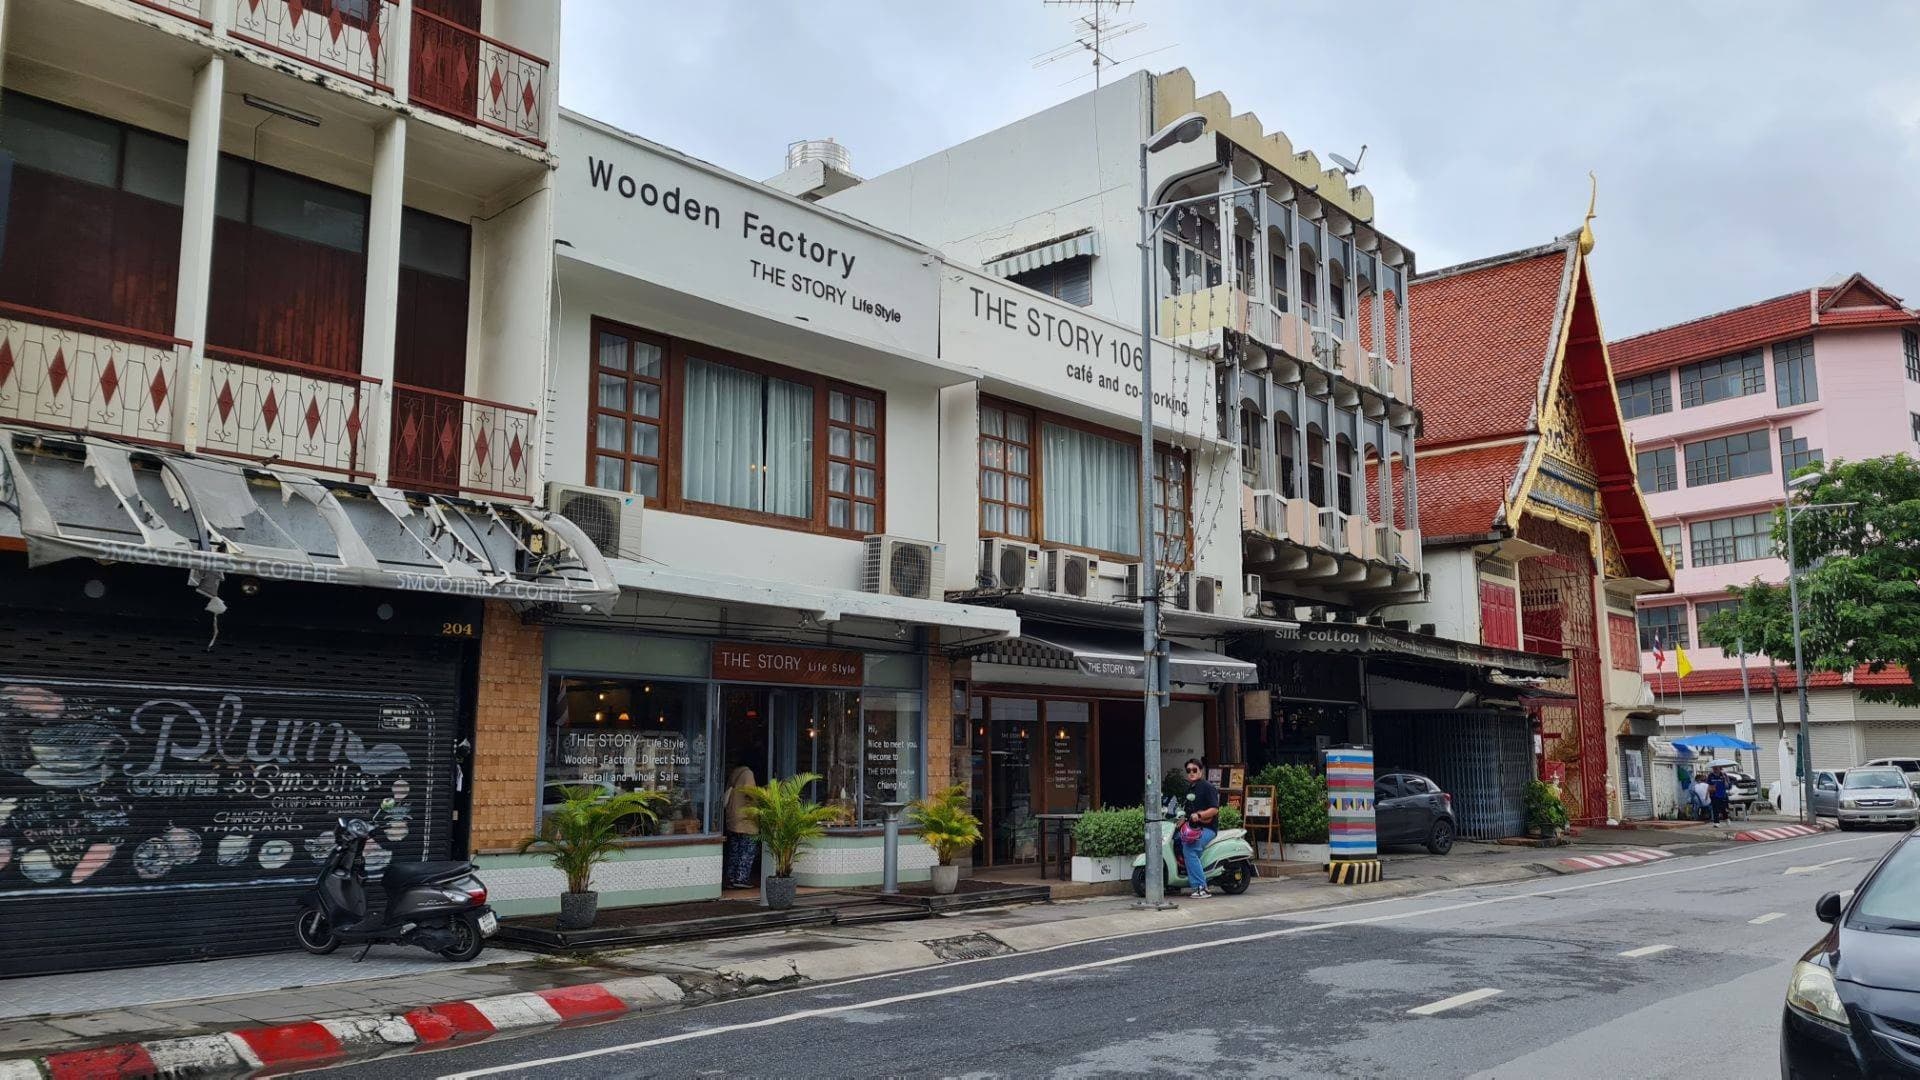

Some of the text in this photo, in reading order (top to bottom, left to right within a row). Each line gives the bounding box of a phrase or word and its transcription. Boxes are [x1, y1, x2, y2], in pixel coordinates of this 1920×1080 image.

[588, 156, 856, 278] Wooden Factory
[750, 259, 902, 323] THE STORY Life Style
[969, 286, 1143, 372] THE STORY 106
[1066, 362, 1188, 417] café and co-orking
[97, 543, 338, 583] SMOOTHIES COFFEE
[395, 574, 578, 604] SMOOTHIES COFFEE
[442, 623, 473, 635] 204
[721, 652, 856, 675] THE STORY Life Style
[1088, 662, 1101, 673] THE
[1102, 663, 1124, 675] STORY
[122, 694, 347, 777] Plum
[569, 733, 684, 750] THE STORY Life Style
[565, 753, 690, 767] Wooden Factory Direct Shop
[582, 772, 607, 782] Retail
[610, 773, 627, 782] and
[660, 772, 679, 782] Sale
[879, 768, 898, 776] STORY
[201, 824, 304, 833] THAILAND
